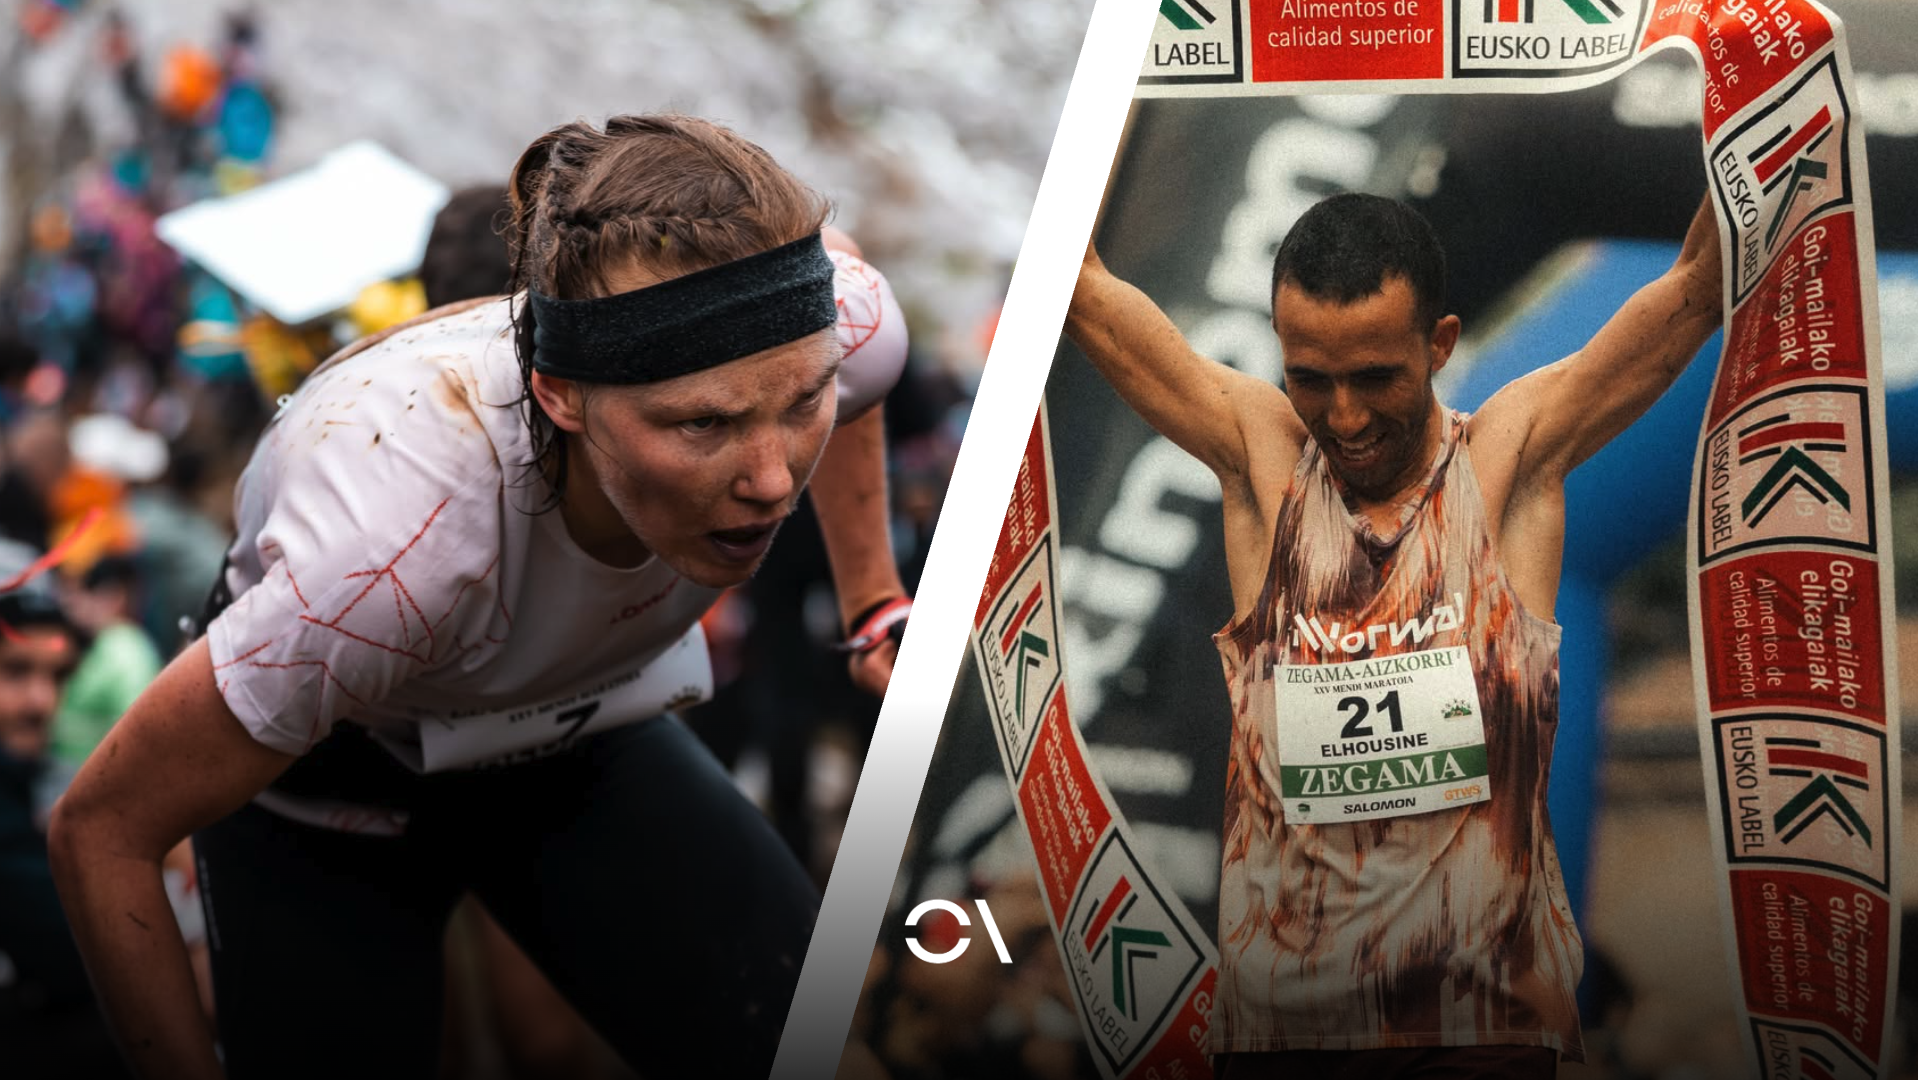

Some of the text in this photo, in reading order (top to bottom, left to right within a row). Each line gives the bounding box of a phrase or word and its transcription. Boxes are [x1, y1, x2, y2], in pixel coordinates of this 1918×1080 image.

[1154, 42, 1230, 66] LABEL
[1267, 24, 1434, 50] calidad superior
[1280, 0, 1419, 19] Alimentos de
[1467, 33, 1629, 59] EUSKO LABEL
[1658, 0, 1710, 23] calida
[1721, 0, 1781, 66] gaiak
[1704, 70, 1726, 114] erior
[1719, 151, 1759, 228] EUSKO
[1742, 227, 1760, 289] LABEL
[1773, 254, 1804, 366] elikagaiak
[1803, 225, 1836, 371] Goi-mailako
[1020, 454, 1036, 546] mailako
[1712, 429, 1732, 550] EUSKO LABEL
[1287, 650, 1453, 684] ZEGAMA-AIZKORRI
[1314, 675, 1413, 695] XXV MENDI MARATOIA
[1729, 571, 1761, 698] calidad superior
[1755, 577, 1786, 687] Alimentos de
[1798, 570, 1834, 691] elikagaiak
[1829, 560, 1862, 709] Goi-mailako
[986, 630, 1021, 758] EUSKO LABEL
[1321, 733, 1428, 757] ELHOUSINE
[1337, 690, 1404, 739] 21
[1044, 739, 1082, 853] elikagaiak
[1049, 705, 1095, 843] Goi-mailako
[1300, 752, 1466, 795] ZEGAMA
[1343, 797, 1416, 815] SALOMON
[1444, 785, 1481, 801] GTWS
[1731, 726, 1764, 853] EUSKO LABEL
[1069, 930, 1129, 1057] EUSKO LABEL
[1762, 882, 1793, 1011] calidad superior
[1788, 894, 1817, 1002] Alimentos de
[1827, 896, 1852, 1016] elikagaiak
[1852, 893, 1873, 1042] Goi-mailako
